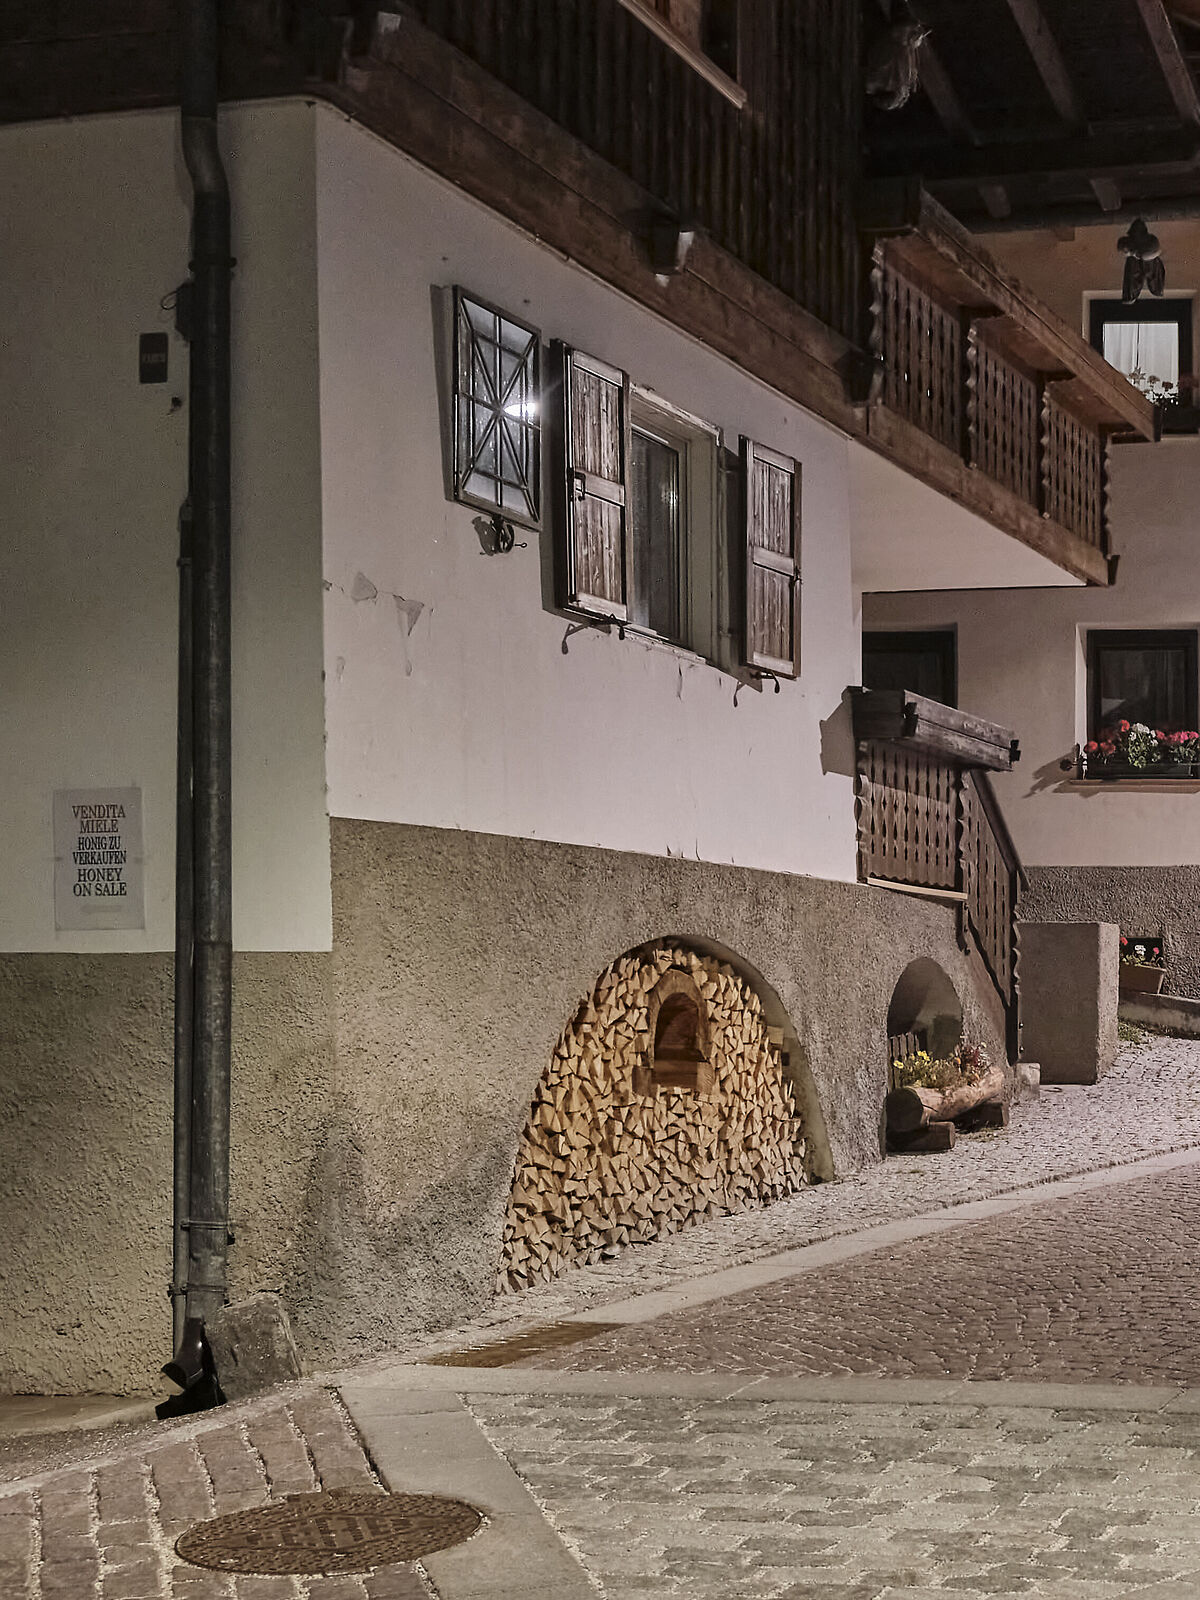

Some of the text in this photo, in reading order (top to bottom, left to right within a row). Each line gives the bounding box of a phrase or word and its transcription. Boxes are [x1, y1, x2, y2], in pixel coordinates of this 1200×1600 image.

[72, 804, 126, 818] VENDITA
[80, 819, 119, 833] MIELE
[78, 836, 121, 851] HONIG ZU
[72, 851, 127, 865] VERKAUFEN
[77, 868, 123, 882] HONEY
[73, 882, 127, 897] ON SALE
